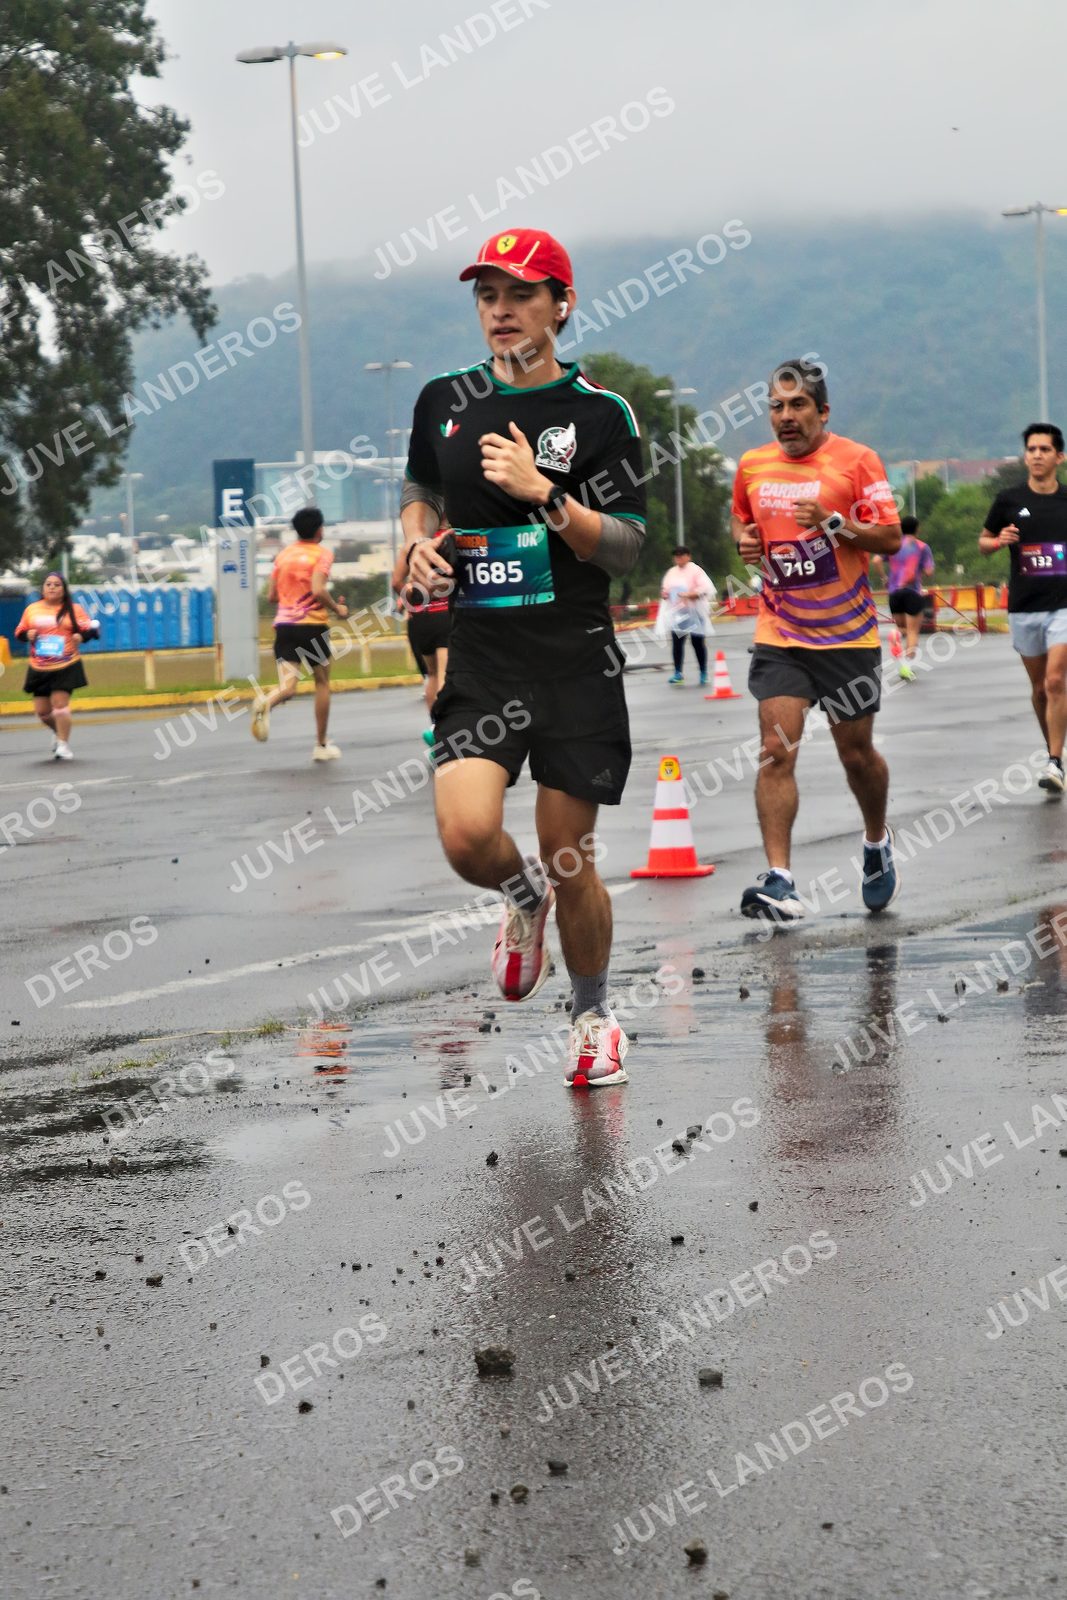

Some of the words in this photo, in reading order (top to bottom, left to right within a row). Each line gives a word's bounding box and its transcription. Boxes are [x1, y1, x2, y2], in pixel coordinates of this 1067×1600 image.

[759, 481, 821, 498] CARRERA
[222, 488, 244, 517] E
[759, 498, 802, 511] OMNIL
[517, 532, 538, 547] 10K
[784, 561, 816, 577] 719
[1031, 556, 1053, 568] 132
[465, 560, 523, 584] 1685
